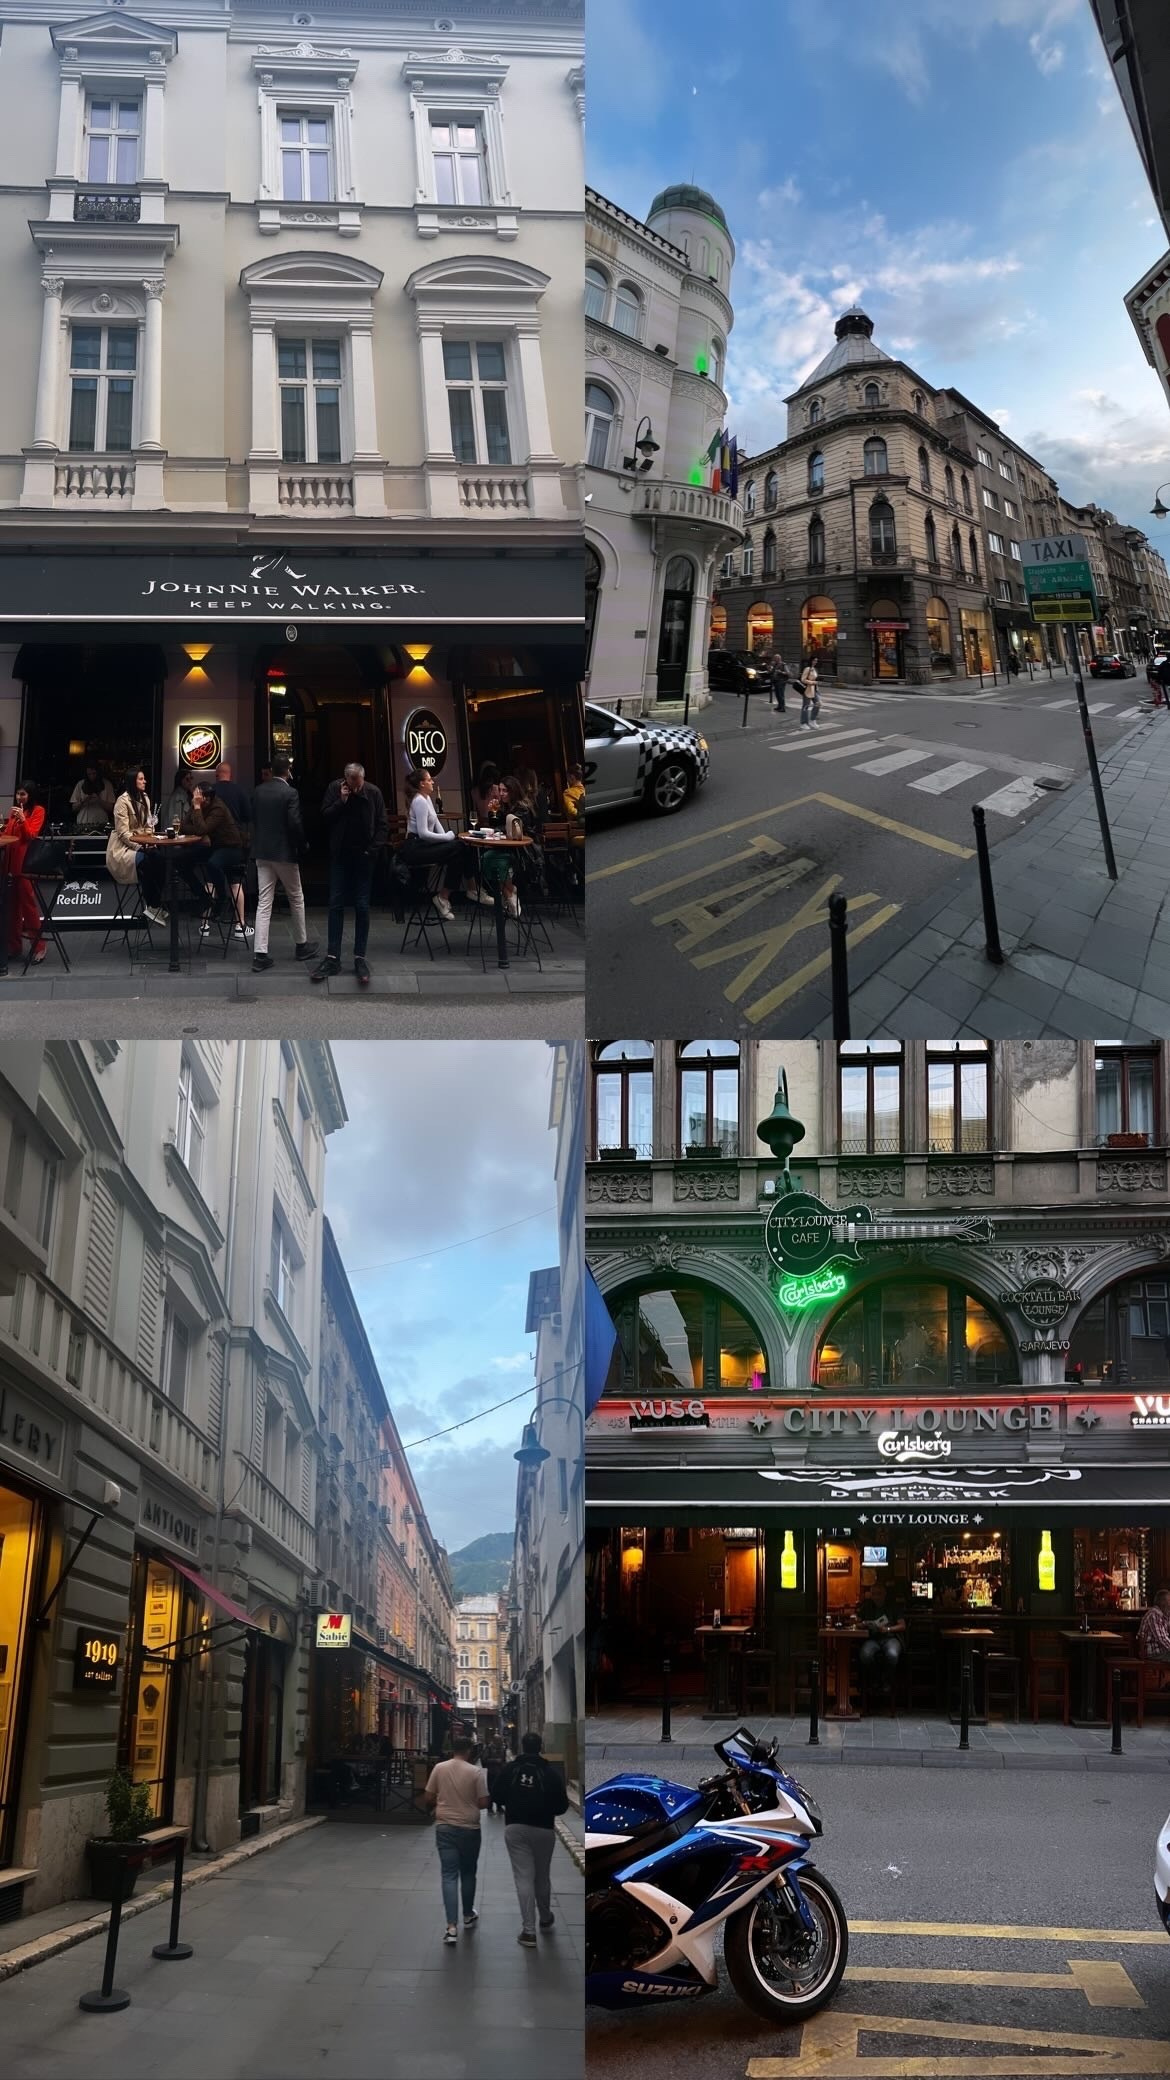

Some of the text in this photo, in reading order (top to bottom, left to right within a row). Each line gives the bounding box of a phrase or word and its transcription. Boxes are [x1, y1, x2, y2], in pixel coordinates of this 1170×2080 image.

[1031, 540, 1074, 560] TAXI
[142, 581, 279, 596] JOHNNIE
[190, 601, 252, 609] KEEP
[409, 730, 446, 754] DECO
[421, 756, 436, 767] BAR
[56, 893, 102, 905] Red Bull
[629, 834, 906, 1025] TAXI
[769, 1215, 847, 1229] CITY LOUNGE
[791, 1233, 820, 1244] CAFE
[779, 1272, 846, 1307] Carlsberg
[1001, 1290, 1081, 1304] COCKTAIL BAR
[1024, 1305, 1065, 1315] LOUNGE
[1021, 1341, 1071, 1352] SARAJEVO
[783, 1405, 1053, 1433] CITY LOUNGE
[877, 1431, 951, 1462] Carlsberg
[830, 1489, 1010, 1498] DENMARK
[872, 1514, 969, 1524] CITY LOUNGE
[84, 1640, 117, 1665] 1919
[621, 1980, 702, 1996] SUZUKI
